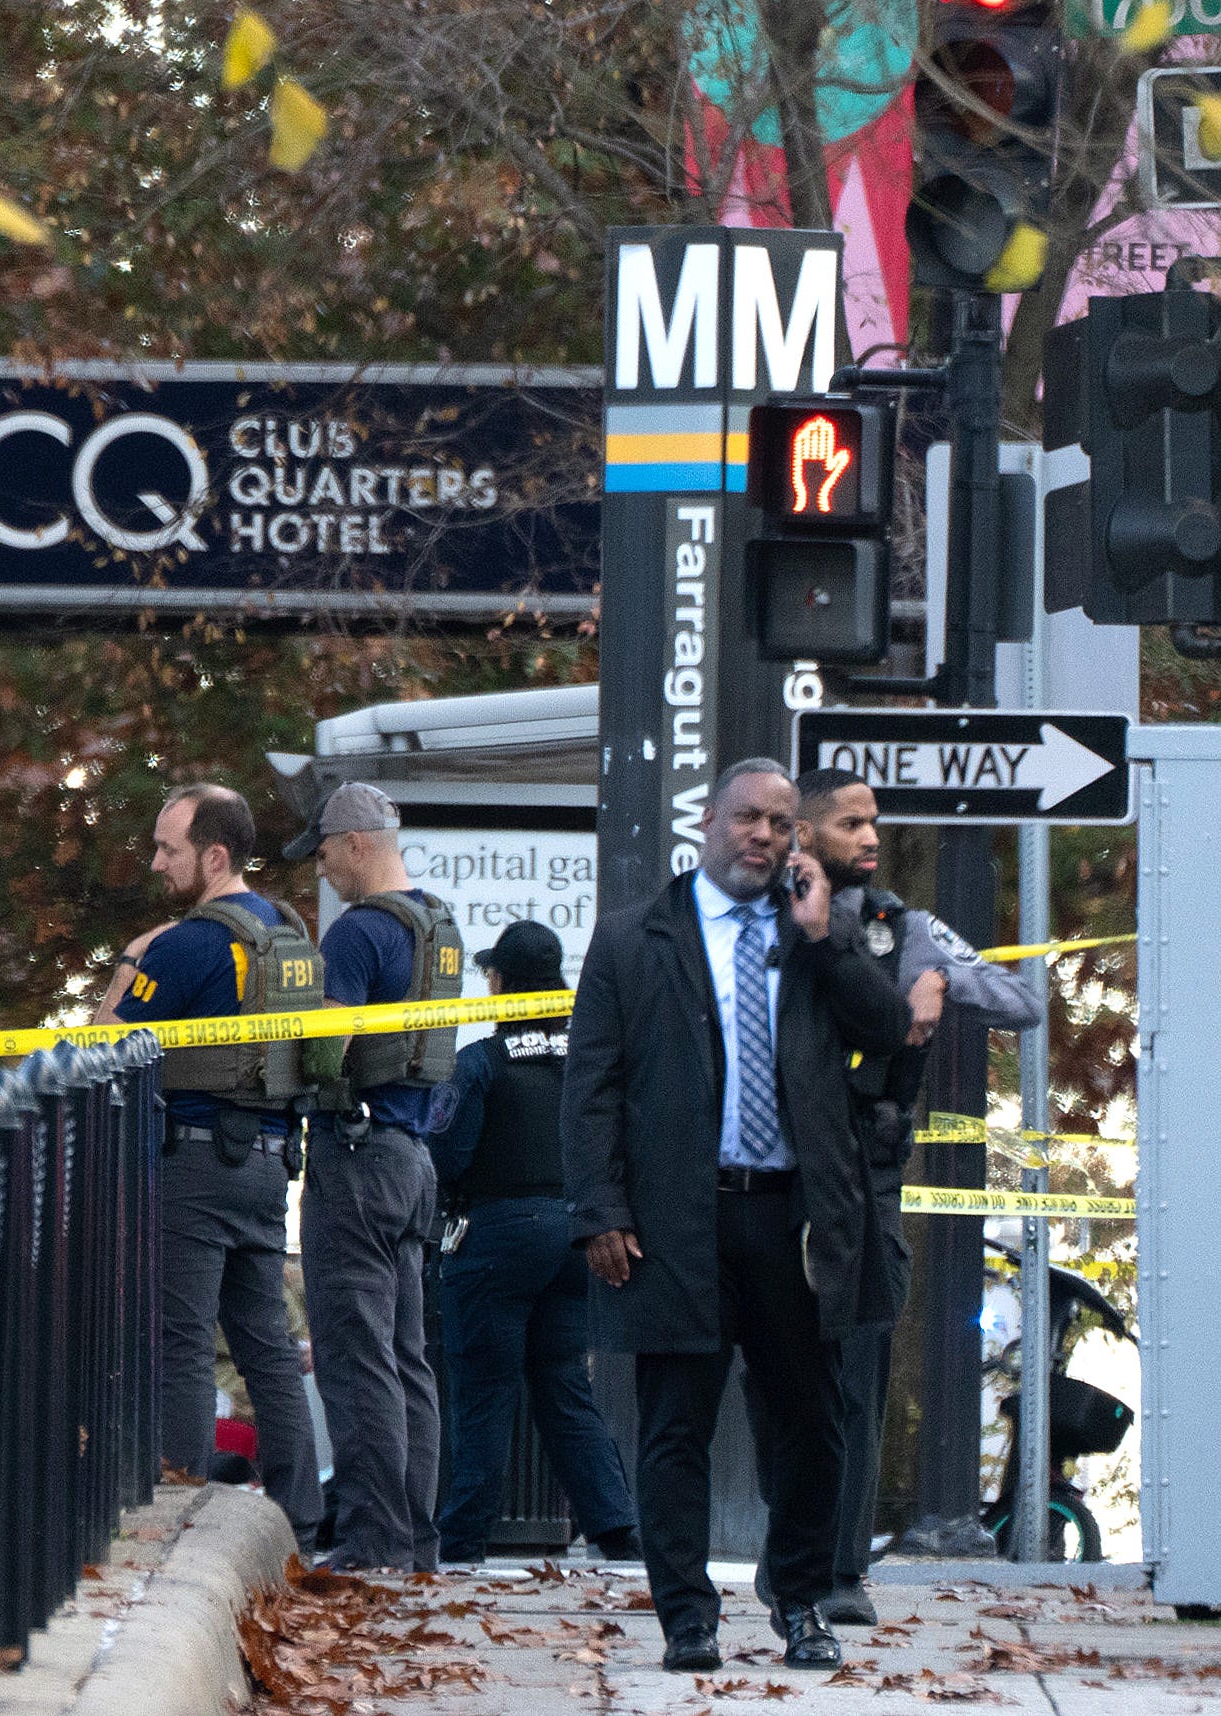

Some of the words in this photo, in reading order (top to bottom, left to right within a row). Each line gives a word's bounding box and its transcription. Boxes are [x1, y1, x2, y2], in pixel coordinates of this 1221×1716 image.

[229, 417, 356, 459] CLUB
[229, 467, 499, 509] QUARTERS
[230, 513, 391, 555] HOTEL
[664, 506, 715, 770] Farragut
[832, 745, 919, 787] ONE
[938, 747, 1029, 787] WAY
[670, 783, 710, 877] We
[401, 845, 538, 888] Capital
[468, 898, 540, 928] rest
[550, 895, 592, 929] of
[282, 958, 313, 988] FBI
[440, 946, 460, 976] FBI
[132, 971, 158, 1003] BI
[505, 1031, 569, 1050] POLIC
